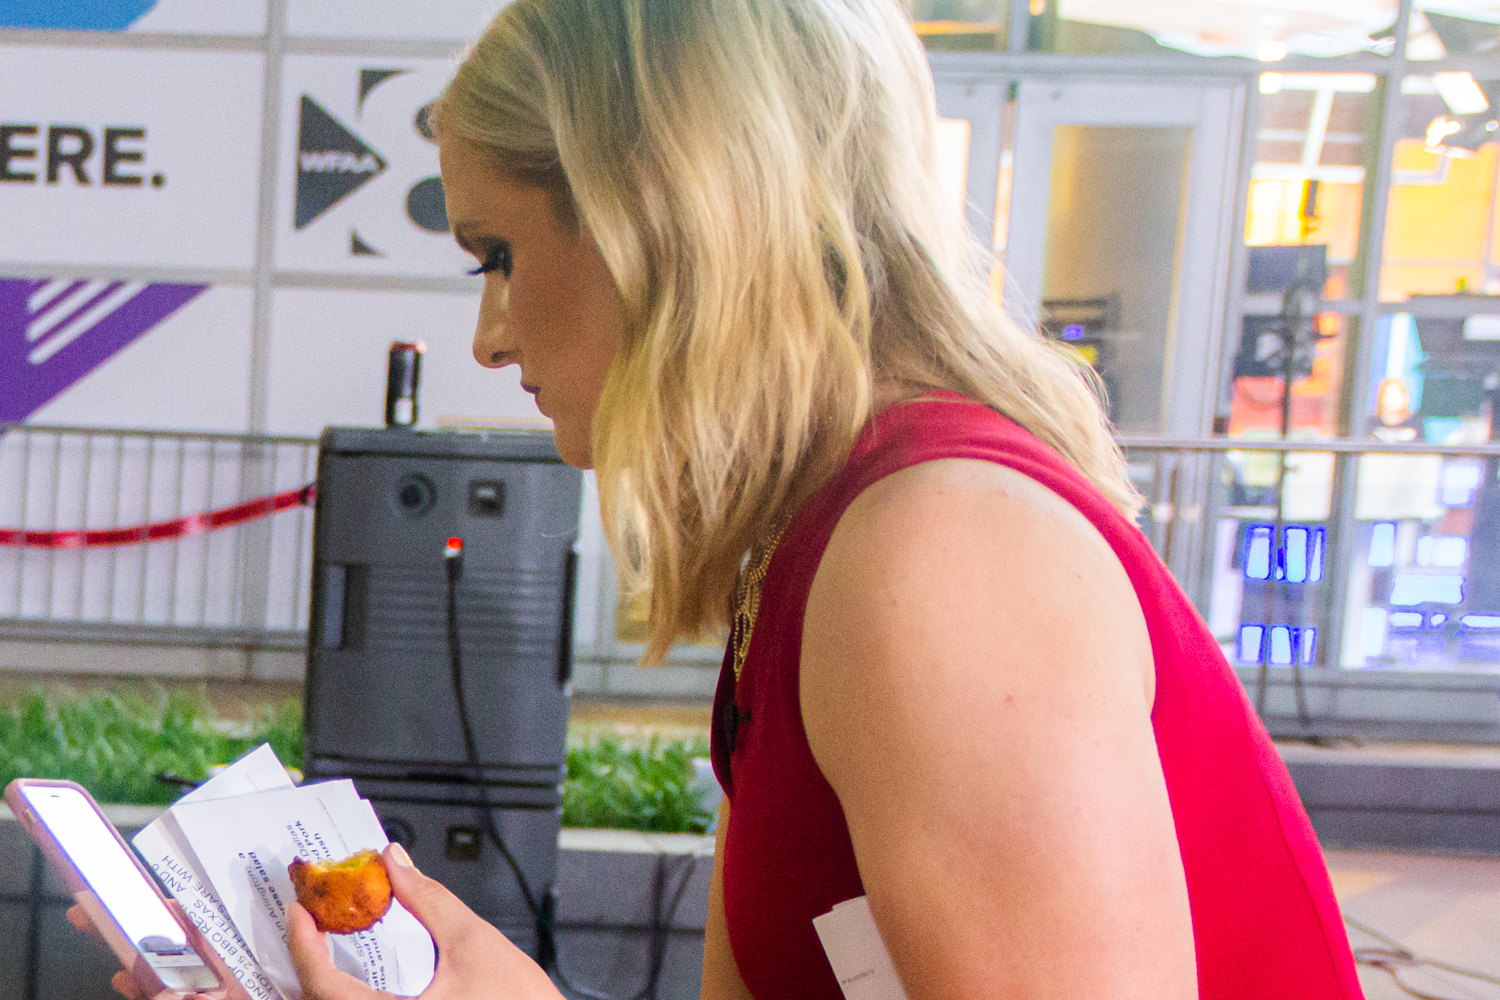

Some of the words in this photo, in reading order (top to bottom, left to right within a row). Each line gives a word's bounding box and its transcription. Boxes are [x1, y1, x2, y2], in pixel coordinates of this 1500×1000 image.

[295, 820, 315, 847] Pork
[161, 855, 193, 883] WITH
[247, 851, 270, 884] salad
[160, 871, 187, 893] AND
[193, 881, 219, 904] ARE
[212, 930, 239, 957] BBQ
[237, 955, 253, 970] 25
[252, 971, 274, 993] TOP
